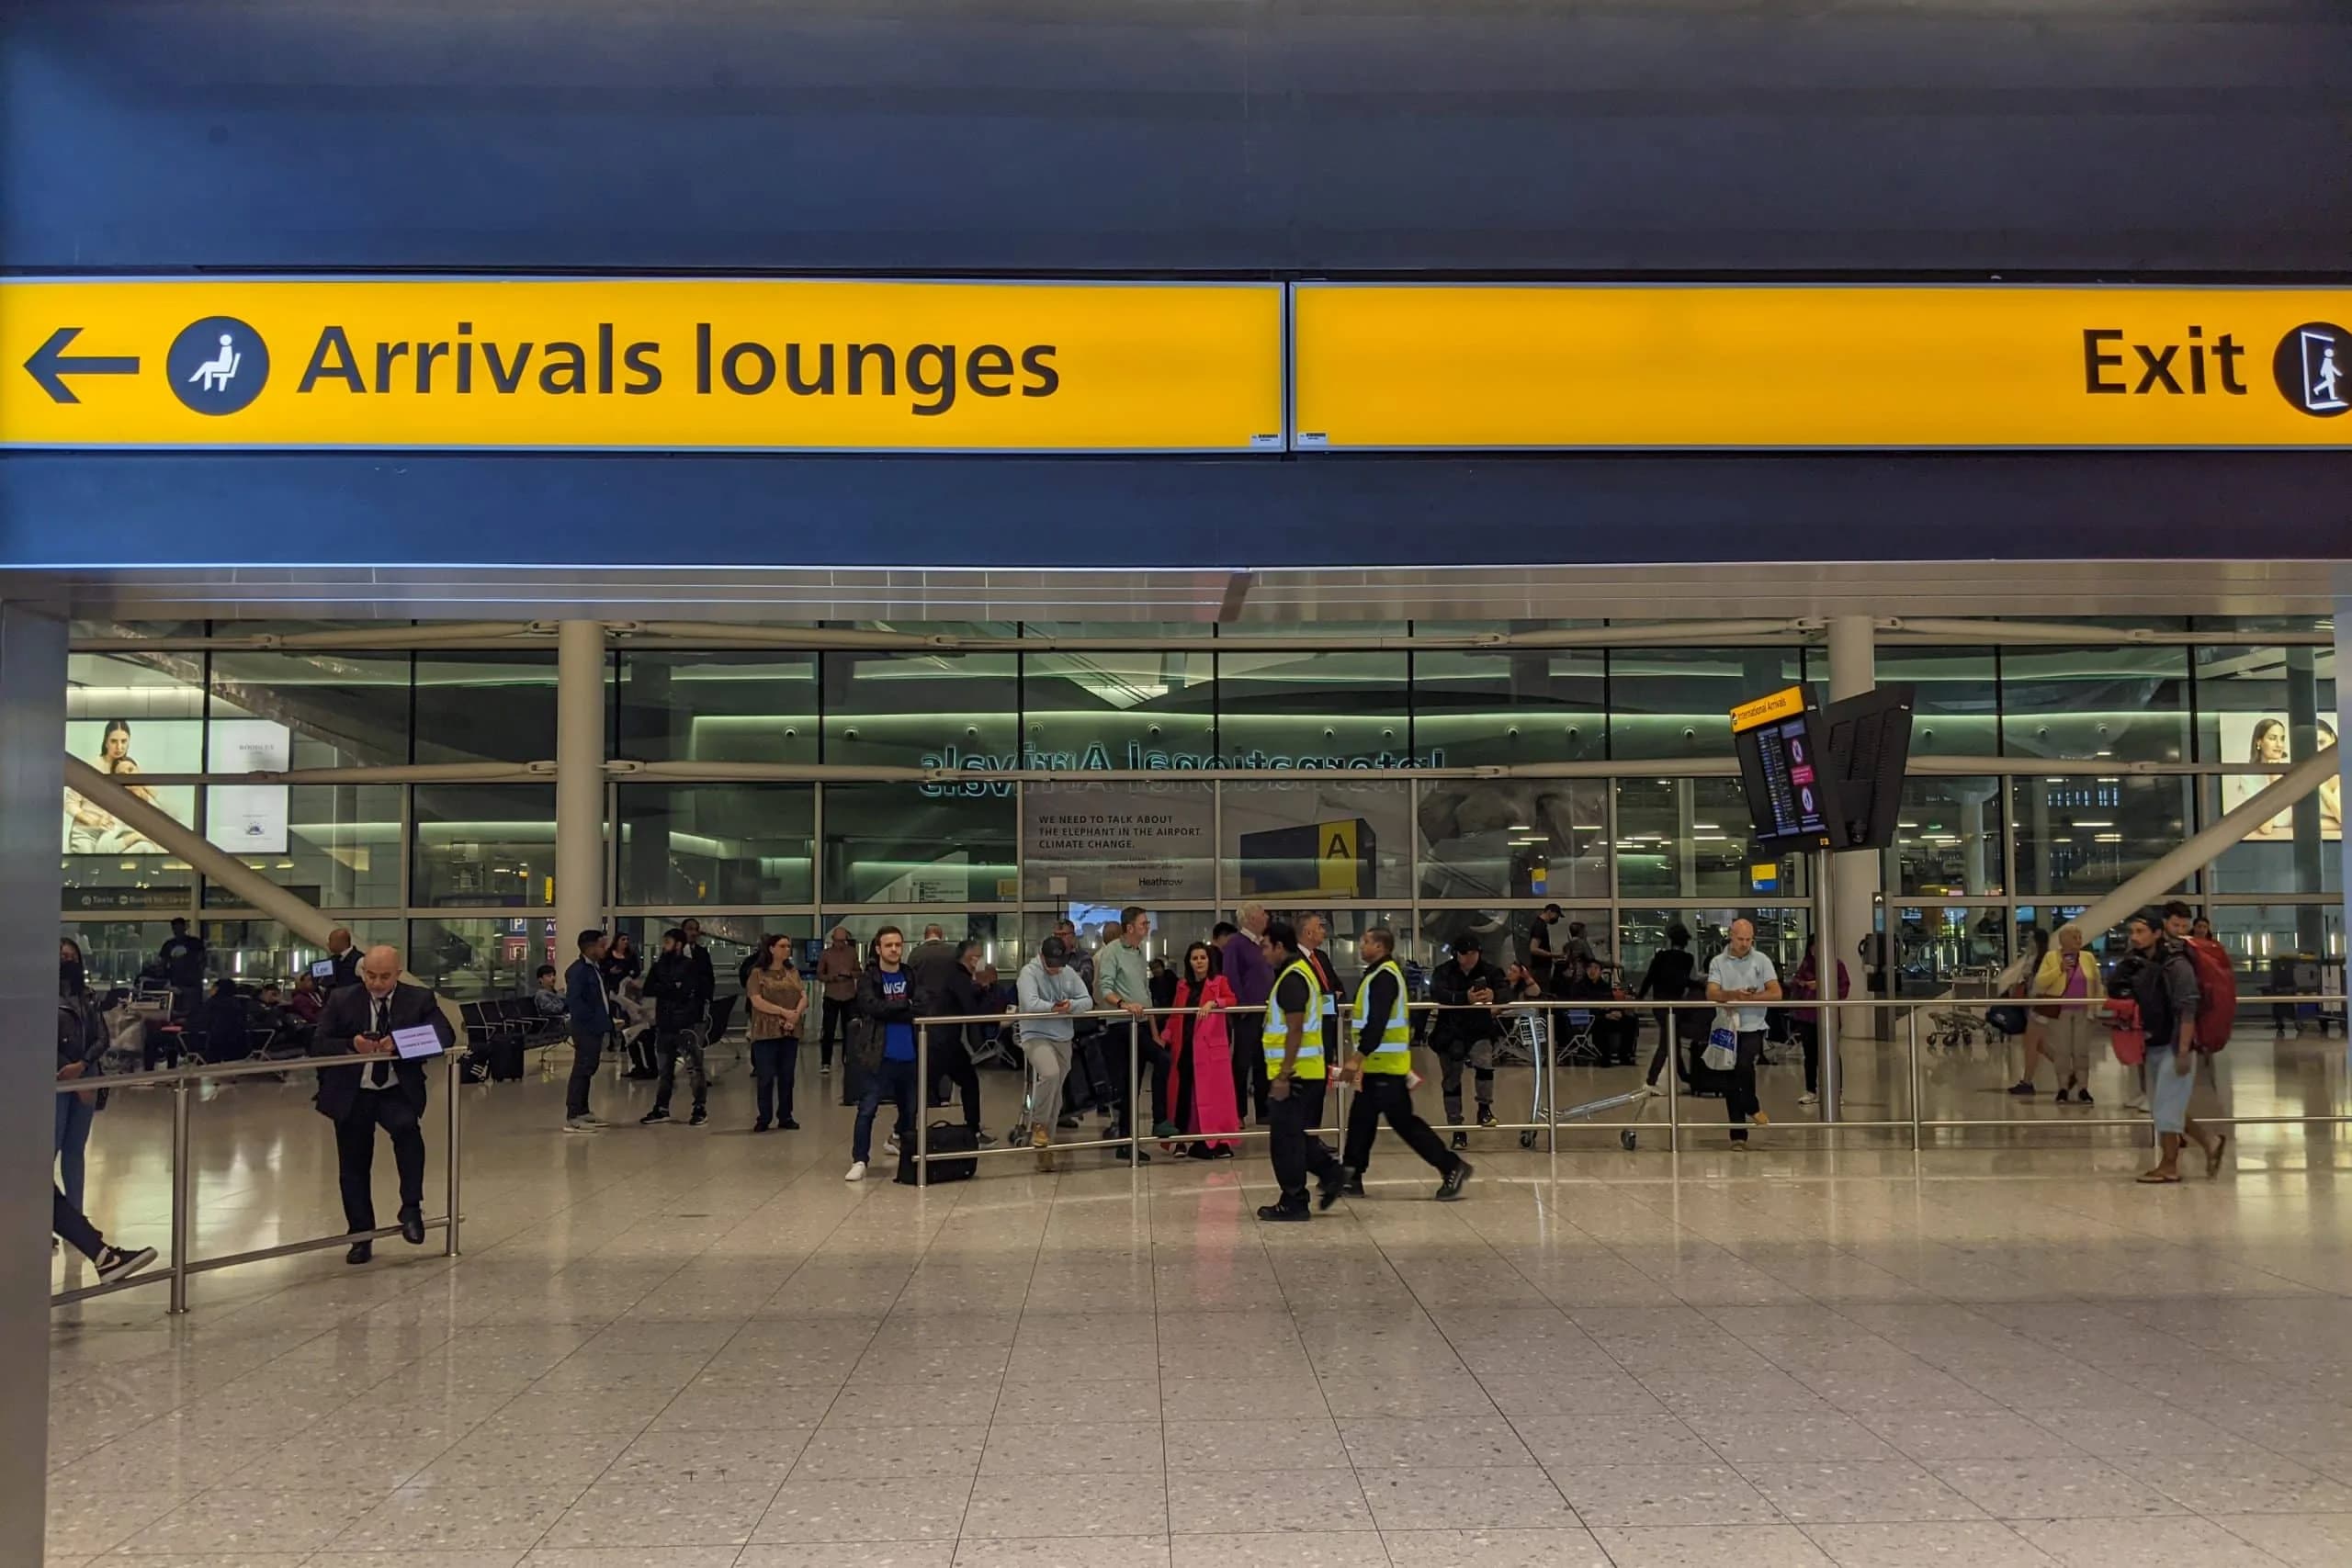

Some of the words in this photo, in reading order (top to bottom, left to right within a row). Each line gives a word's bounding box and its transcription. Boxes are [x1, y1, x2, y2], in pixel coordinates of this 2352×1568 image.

[299, 322, 662, 395] Arrivals
[697, 323, 1058, 415] lounges
[2084, 326, 2246, 395] Exit
[1737, 701, 1767, 717] International
[1767, 695, 1787, 710] Arrivals
[1038, 815, 1056, 824] WE
[1059, 815, 1087, 824] NEED
[1091, 815, 1104, 824] TO
[1107, 815, 1133, 824] TALK
[1136, 815, 1173, 824] ABOUT
[1039, 828, 1059, 836] THE
[1062, 828, 1115, 836] ELEPHANT
[1118, 828, 1130, 836] IN
[1133, 828, 1153, 836] THE
[1038, 840, 1084, 849] CLIMATE
[1087, 840, 1136, 849] CHANGE.
[1326, 833, 1351, 860] A
[1138, 877, 1183, 887] Heathrow
